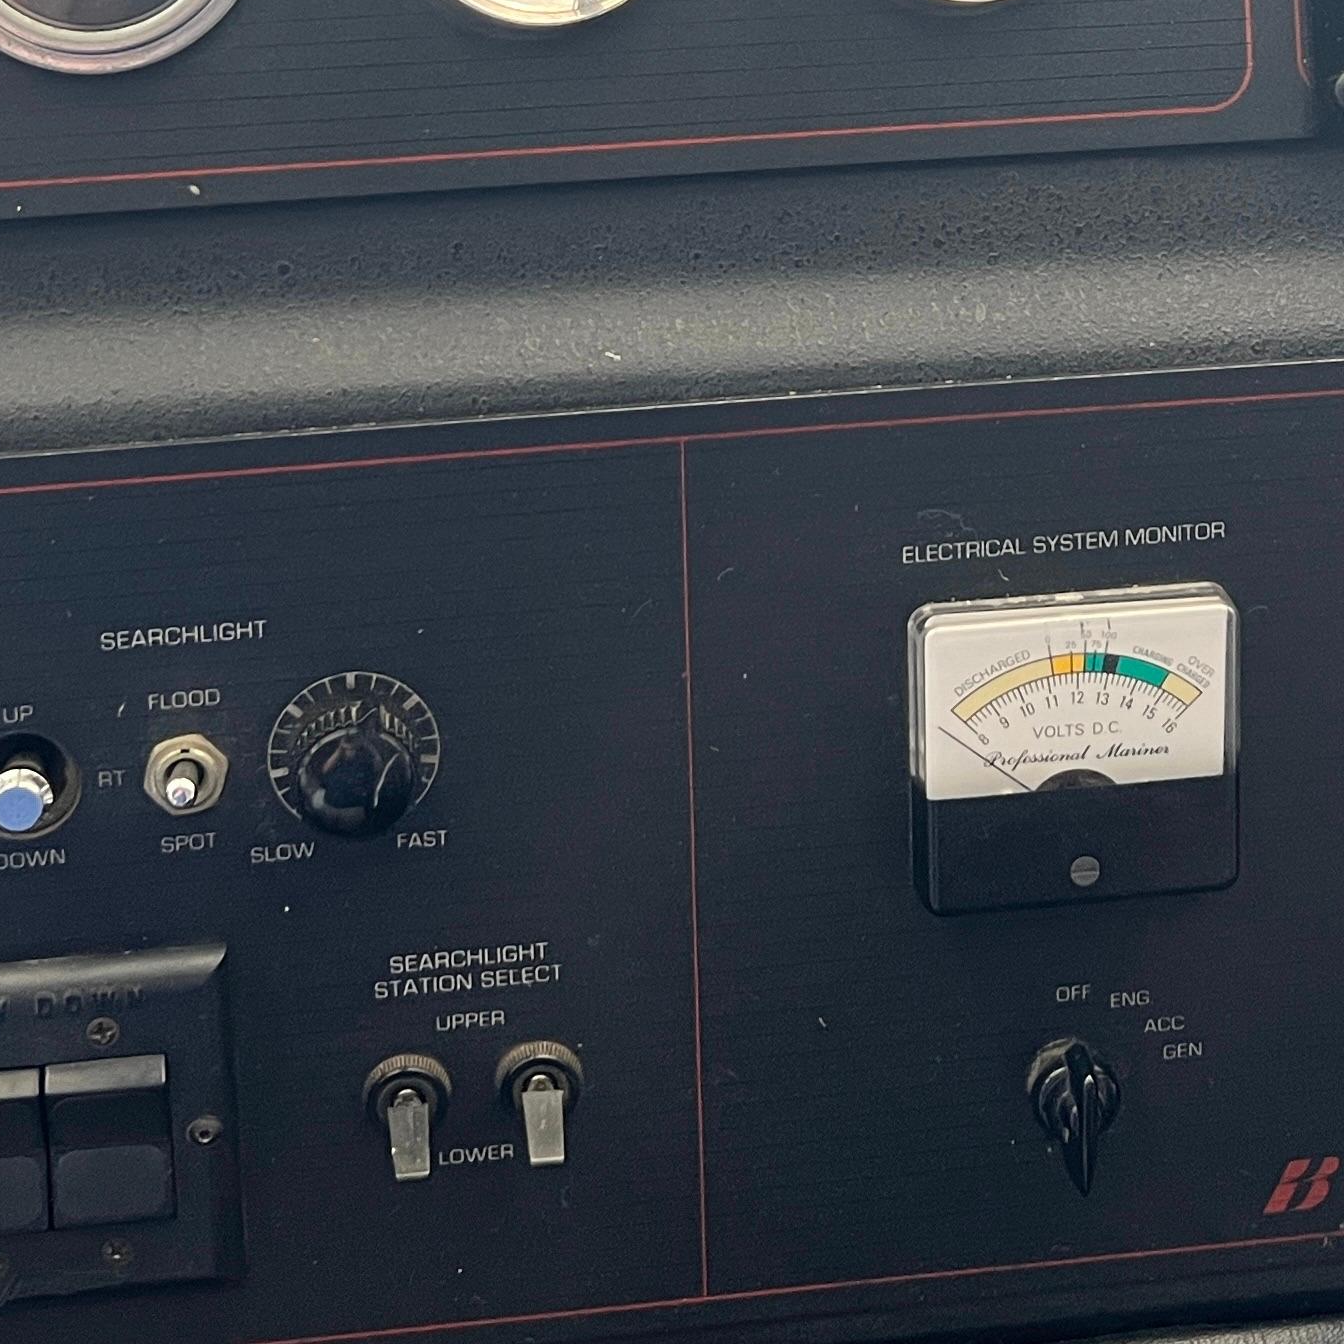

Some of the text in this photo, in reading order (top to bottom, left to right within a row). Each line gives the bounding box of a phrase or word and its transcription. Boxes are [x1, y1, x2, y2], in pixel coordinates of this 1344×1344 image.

[902, 521, 1226, 565] ELECTRICAL SYSTEM MONITOR
[100, 619, 267, 651] SEARCHLIGHT
[953, 649, 1032, 698] DISCHARGED
[1187, 655, 1216, 678] OVER
[147, 688, 221, 711] FLOOD
[1045, 693, 1059, 710] 11
[1071, 690, 1085, 705] 12
[1095, 691, 1110, 706] 13
[1119, 694, 1134, 711] 14
[2, 705, 34, 724] UP
[1020, 702, 1036, 718] 10
[1142, 704, 1159, 720] 15
[999, 716, 1010, 730] 9
[1032, 723, 1085, 739] VOLTS
[1162, 717, 1178, 734] 16
[978, 734, 990, 746] 8
[984, 742, 1170, 771] Professional Mariner
[98, 769, 126, 787] RT
[161, 831, 218, 853] SPOT
[396, 830, 448, 850] FAST
[250, 843, 315, 865] SLOW
[389, 941, 549, 975] SEARCHLIGHT
[374, 962, 563, 1000] STATION SELECT
[34, 986, 147, 1017] DOWN
[1056, 984, 1091, 1002] OFF
[1110, 990, 1150, 1008] ENG
[436, 1010, 505, 1032] UPPER
[1144, 1016, 1185, 1033] ACC
[1163, 1042, 1203, 1059] GEN
[438, 1143, 514, 1166] LOWER
